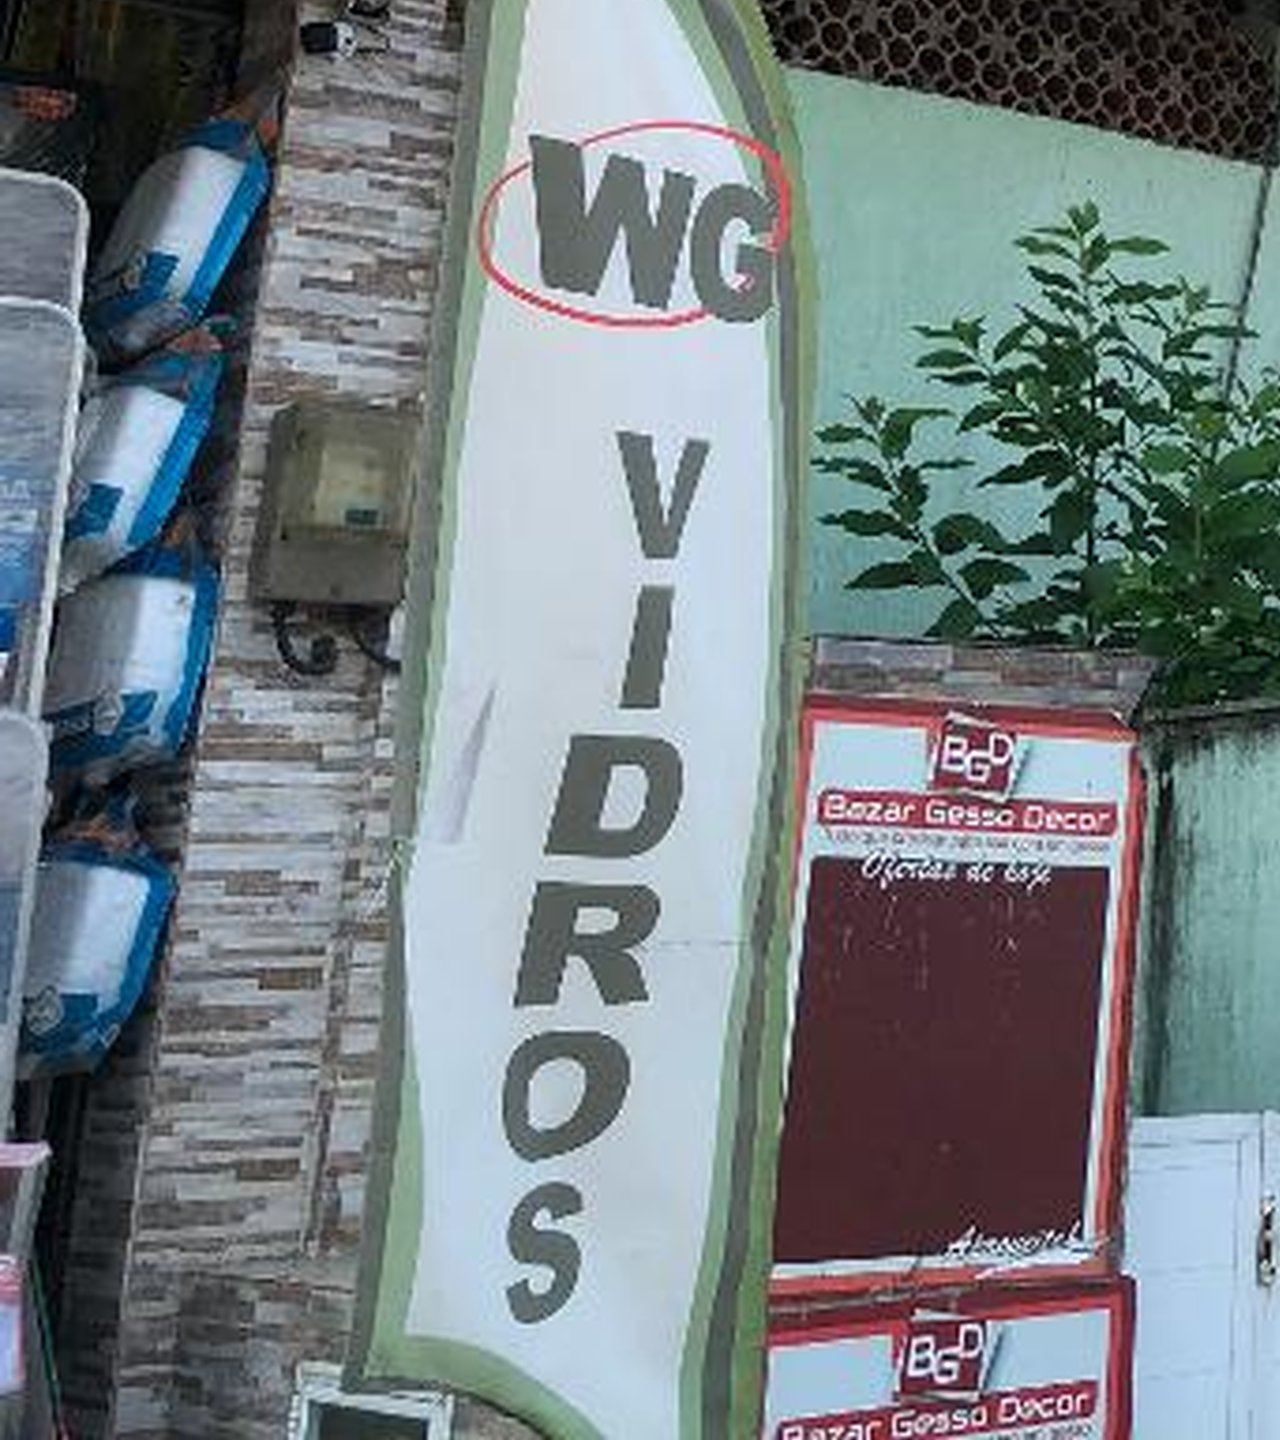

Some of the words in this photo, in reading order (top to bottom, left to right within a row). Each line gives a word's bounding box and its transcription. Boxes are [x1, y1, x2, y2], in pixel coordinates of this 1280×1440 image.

[528, 134, 781, 323] WG
[823, 794, 916, 822] Bazar
[925, 799, 1014, 827] Gesso
[1023, 805, 1110, 832] Decor
[501, 430, 710, 1325] VIDROS
[1000, 1393, 1089, 1422] Decor
